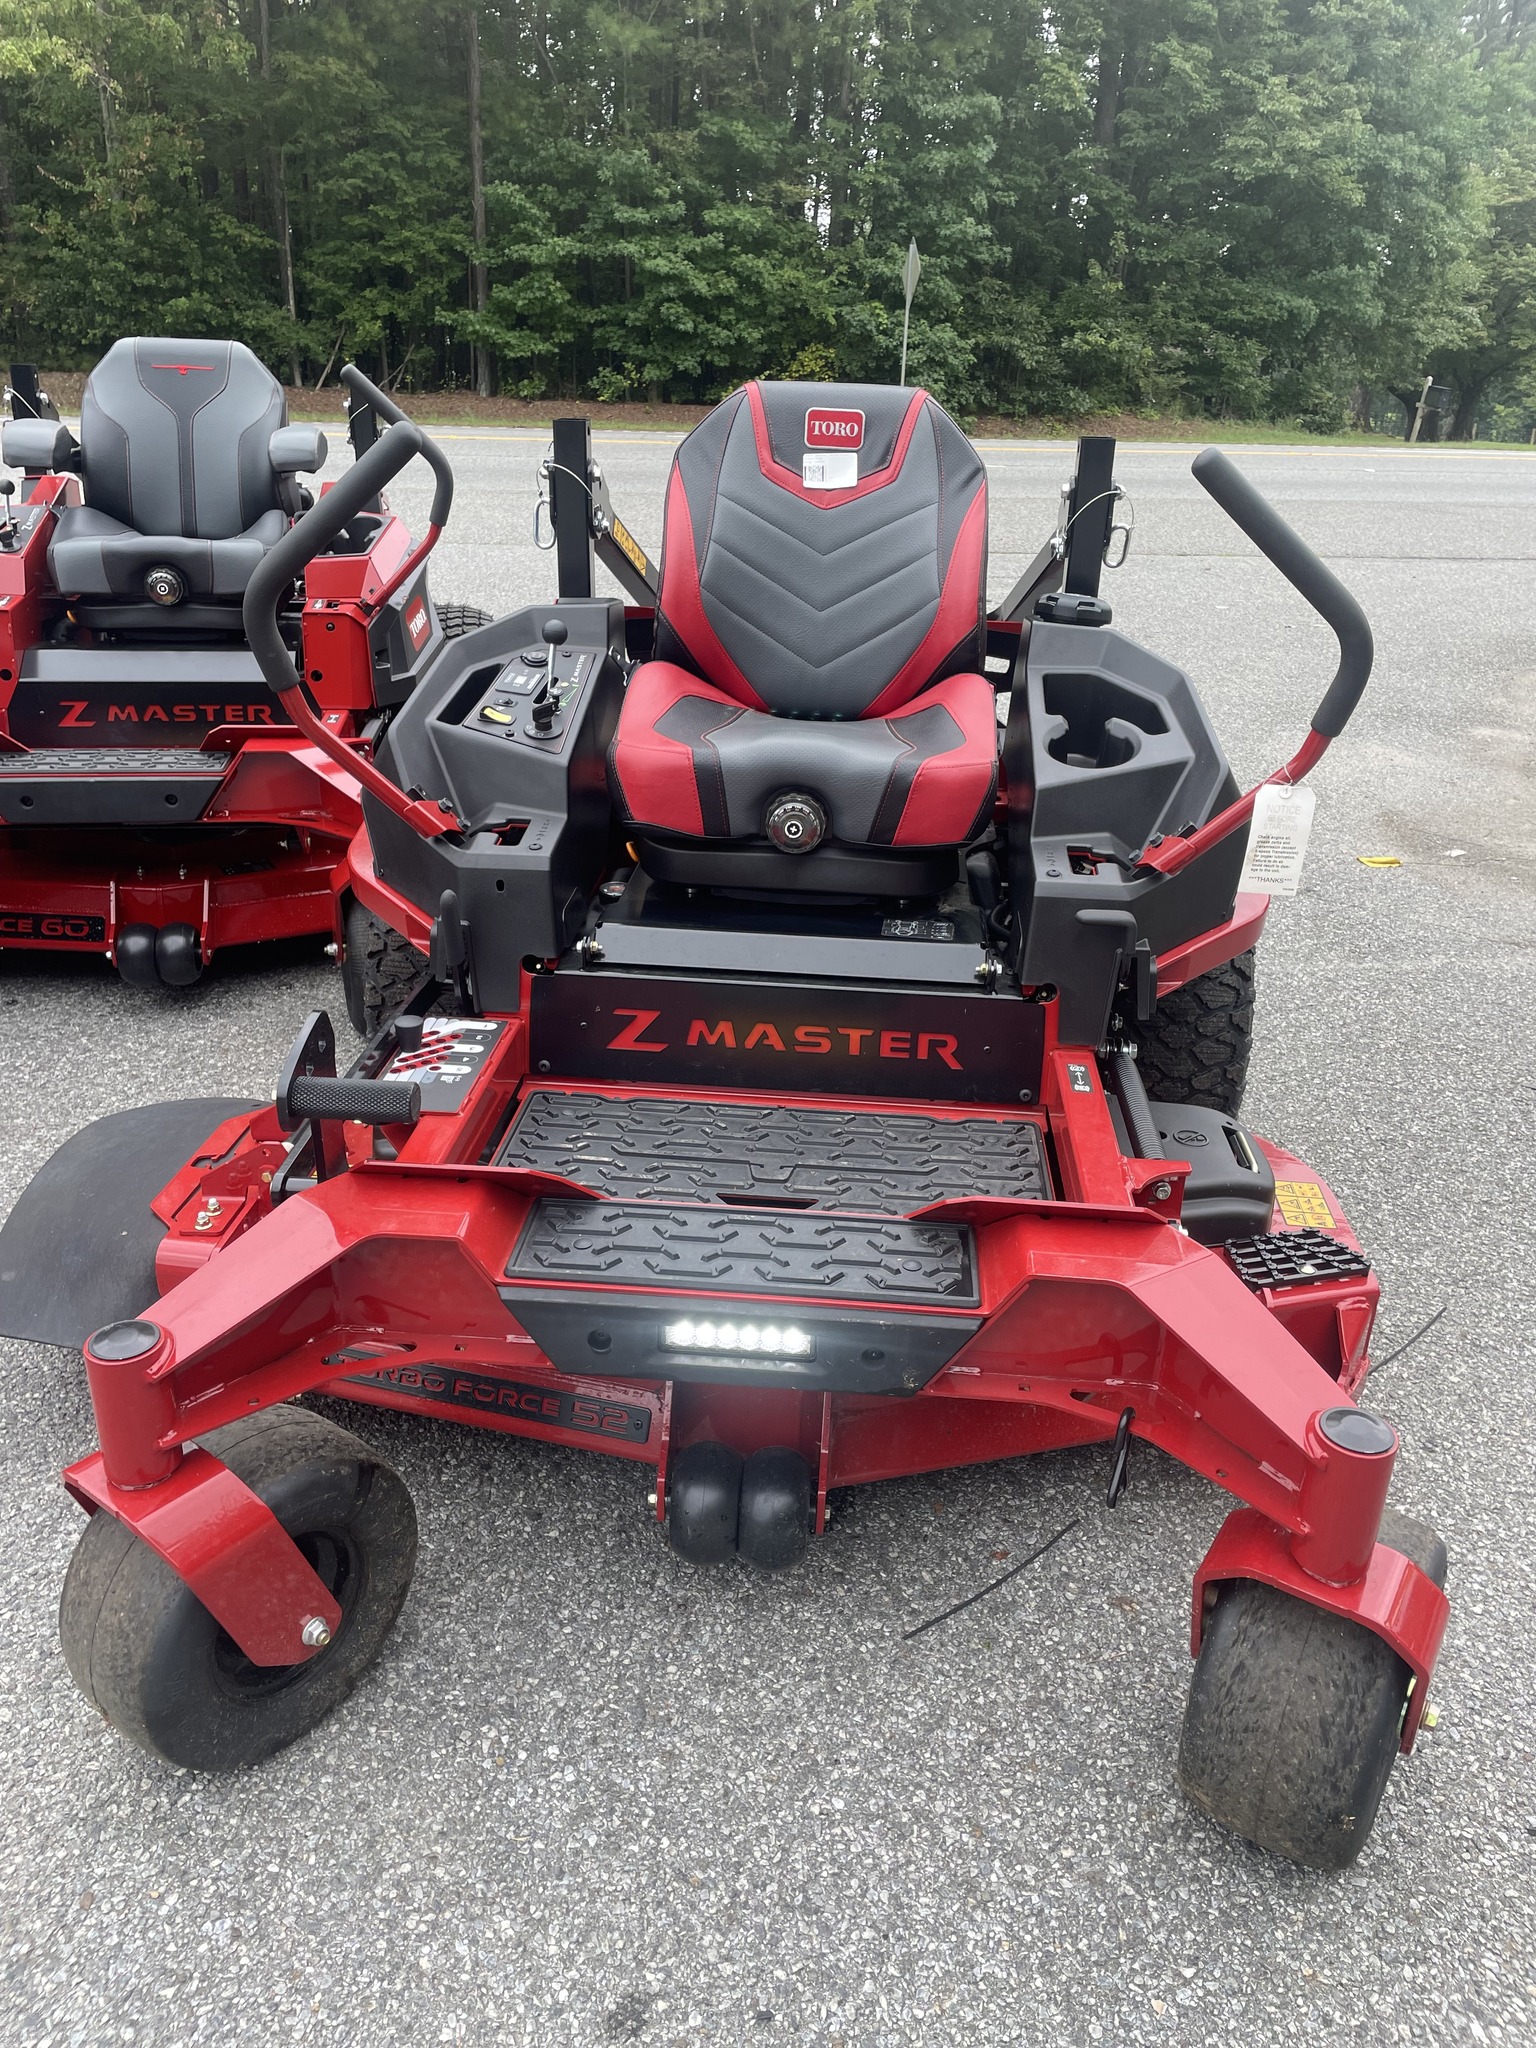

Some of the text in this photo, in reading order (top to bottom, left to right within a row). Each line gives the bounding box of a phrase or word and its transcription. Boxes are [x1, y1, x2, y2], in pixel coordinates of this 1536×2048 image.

[810, 420, 859, 437] TORO
[409, 608, 428, 639] TORO
[570, 654, 587, 683] Z MASTER
[58, 701, 276, 727] Z MASTER
[1266, 804, 1302, 815] NOTICE
[1263, 822, 1298, 832] STARTING
[41, 919, 90, 937] 60
[605, 1007, 964, 1071] Z MASTER
[452, 1377, 562, 1418] FORCE
[571, 1400, 630, 1436] 52
